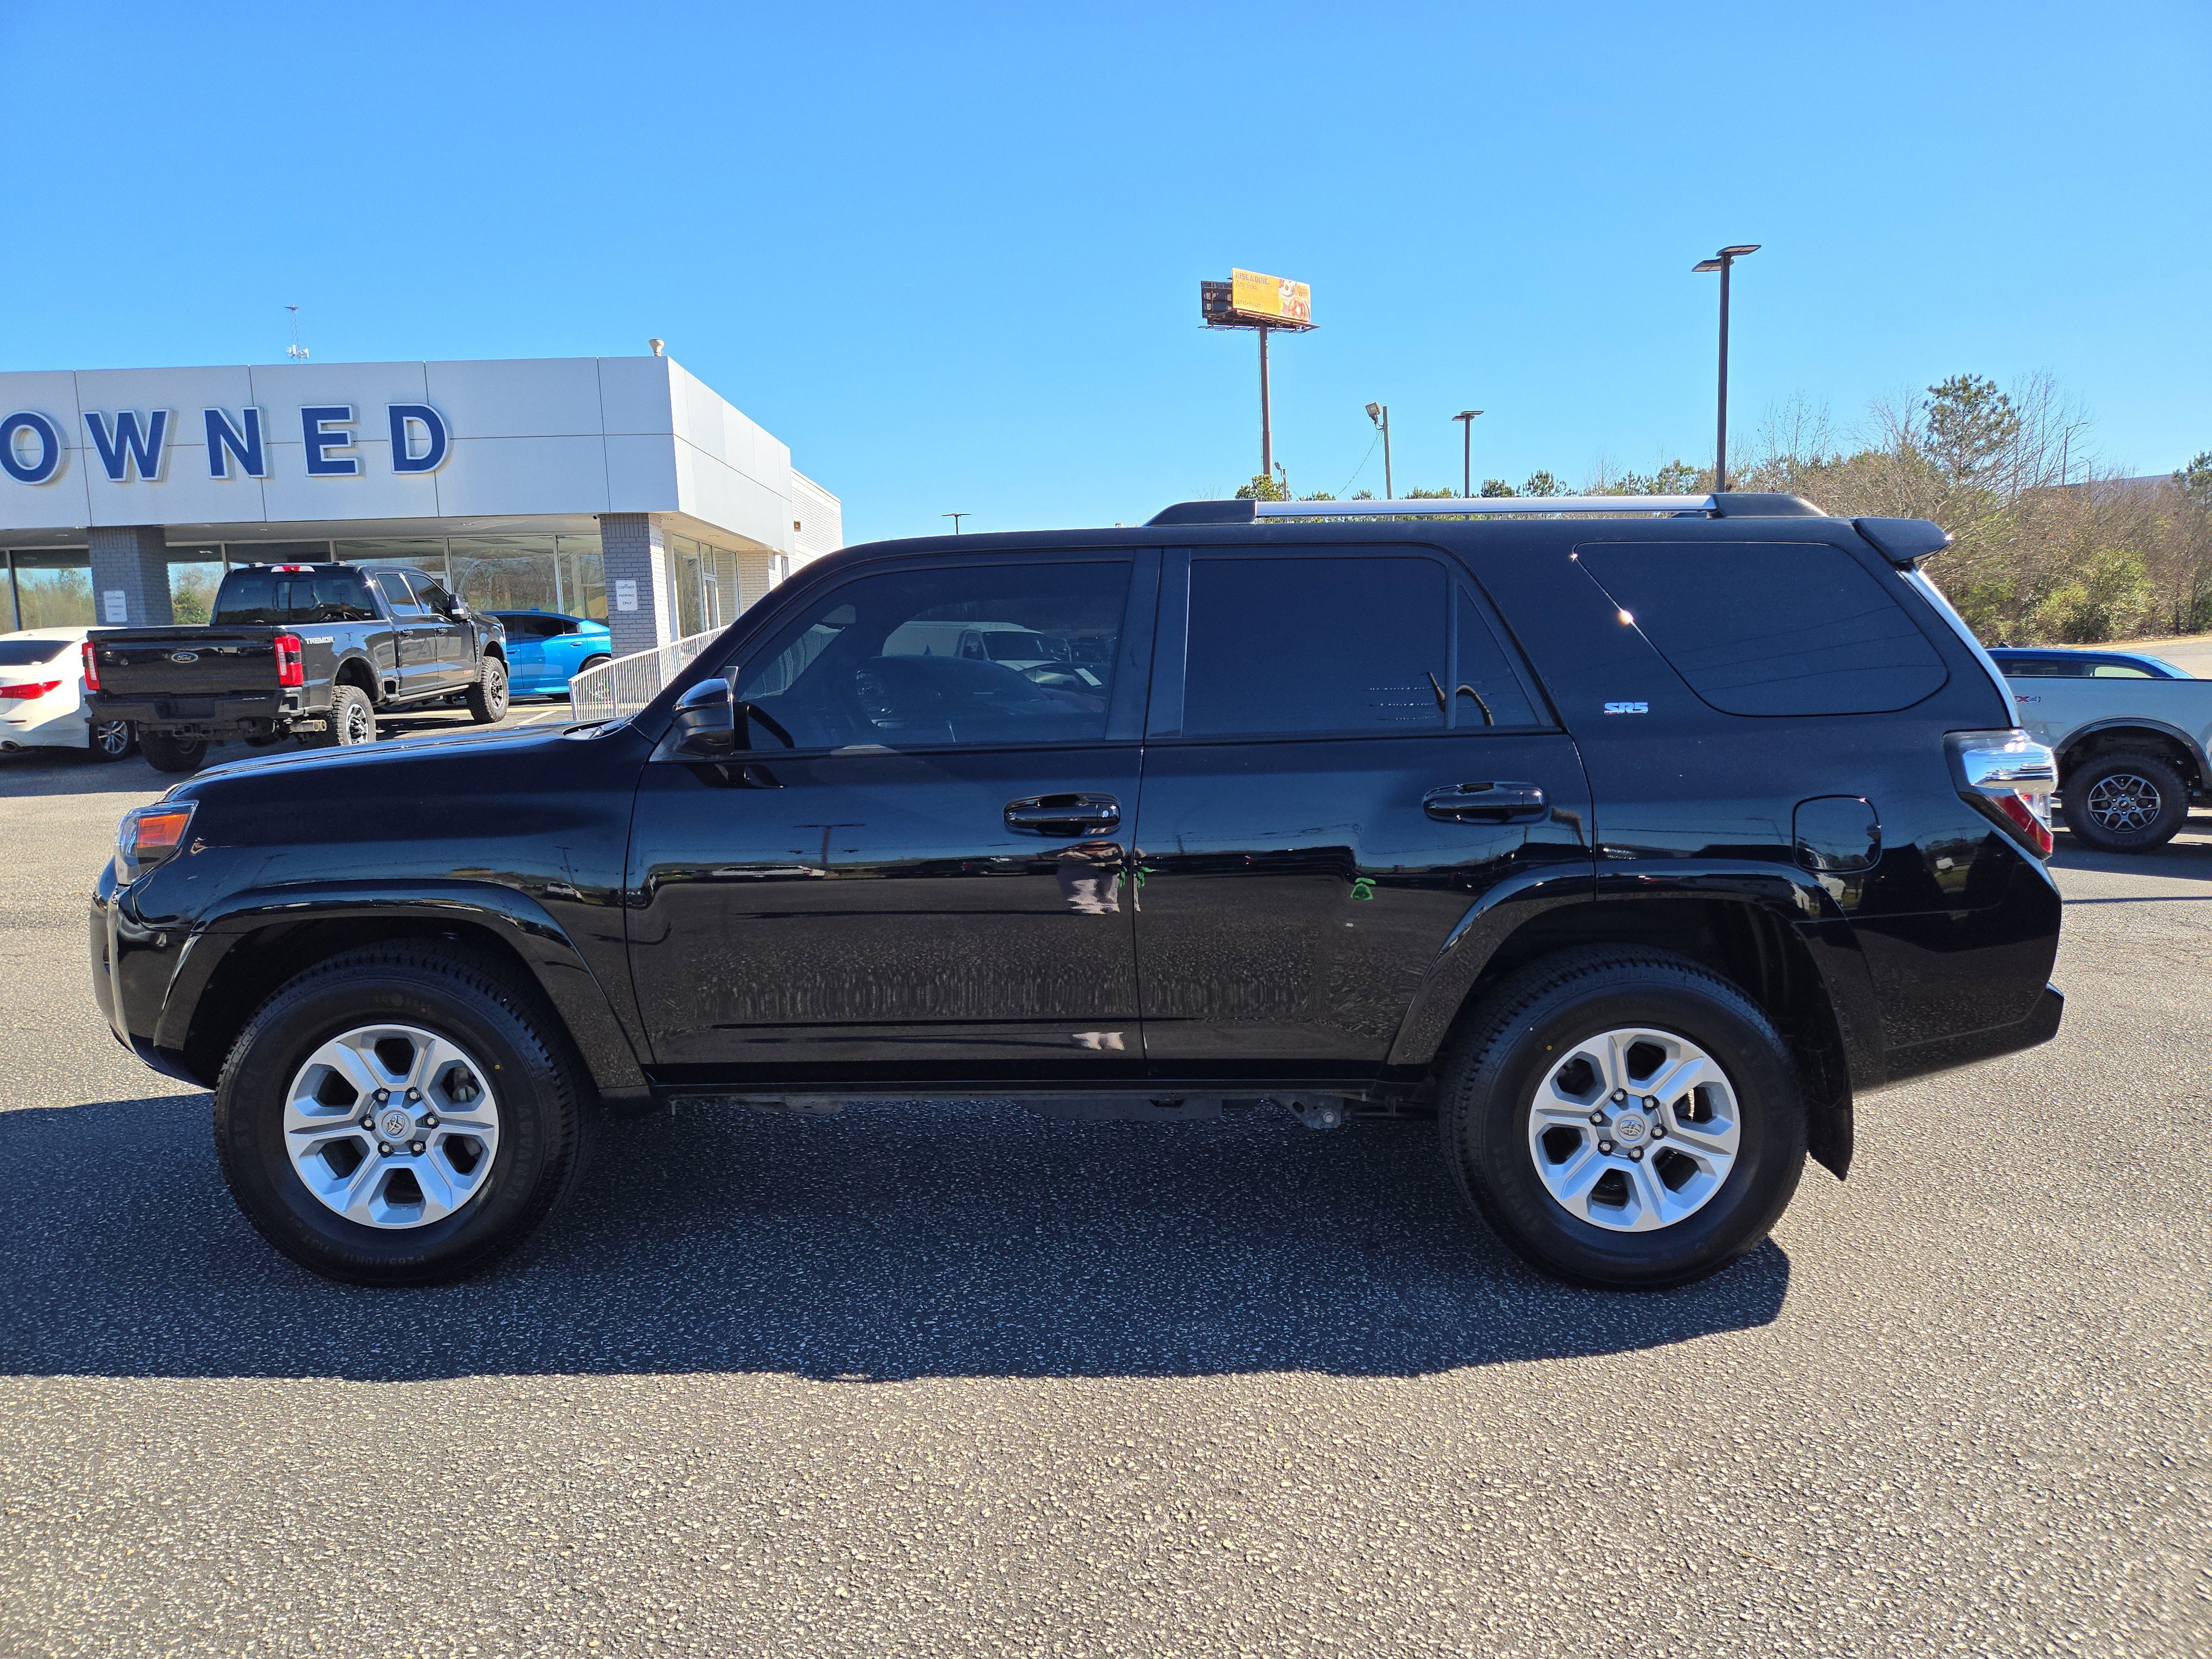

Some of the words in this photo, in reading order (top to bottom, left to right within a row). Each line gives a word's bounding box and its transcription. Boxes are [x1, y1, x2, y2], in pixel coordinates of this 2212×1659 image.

[1236, 272, 1249, 281] RISE
[0, 403, 448, 486] OWNED
[305, 636, 335, 645] TREMOR
[1604, 702, 1648, 714] SR5
[502, 1104, 535, 1202] ADVANTA
